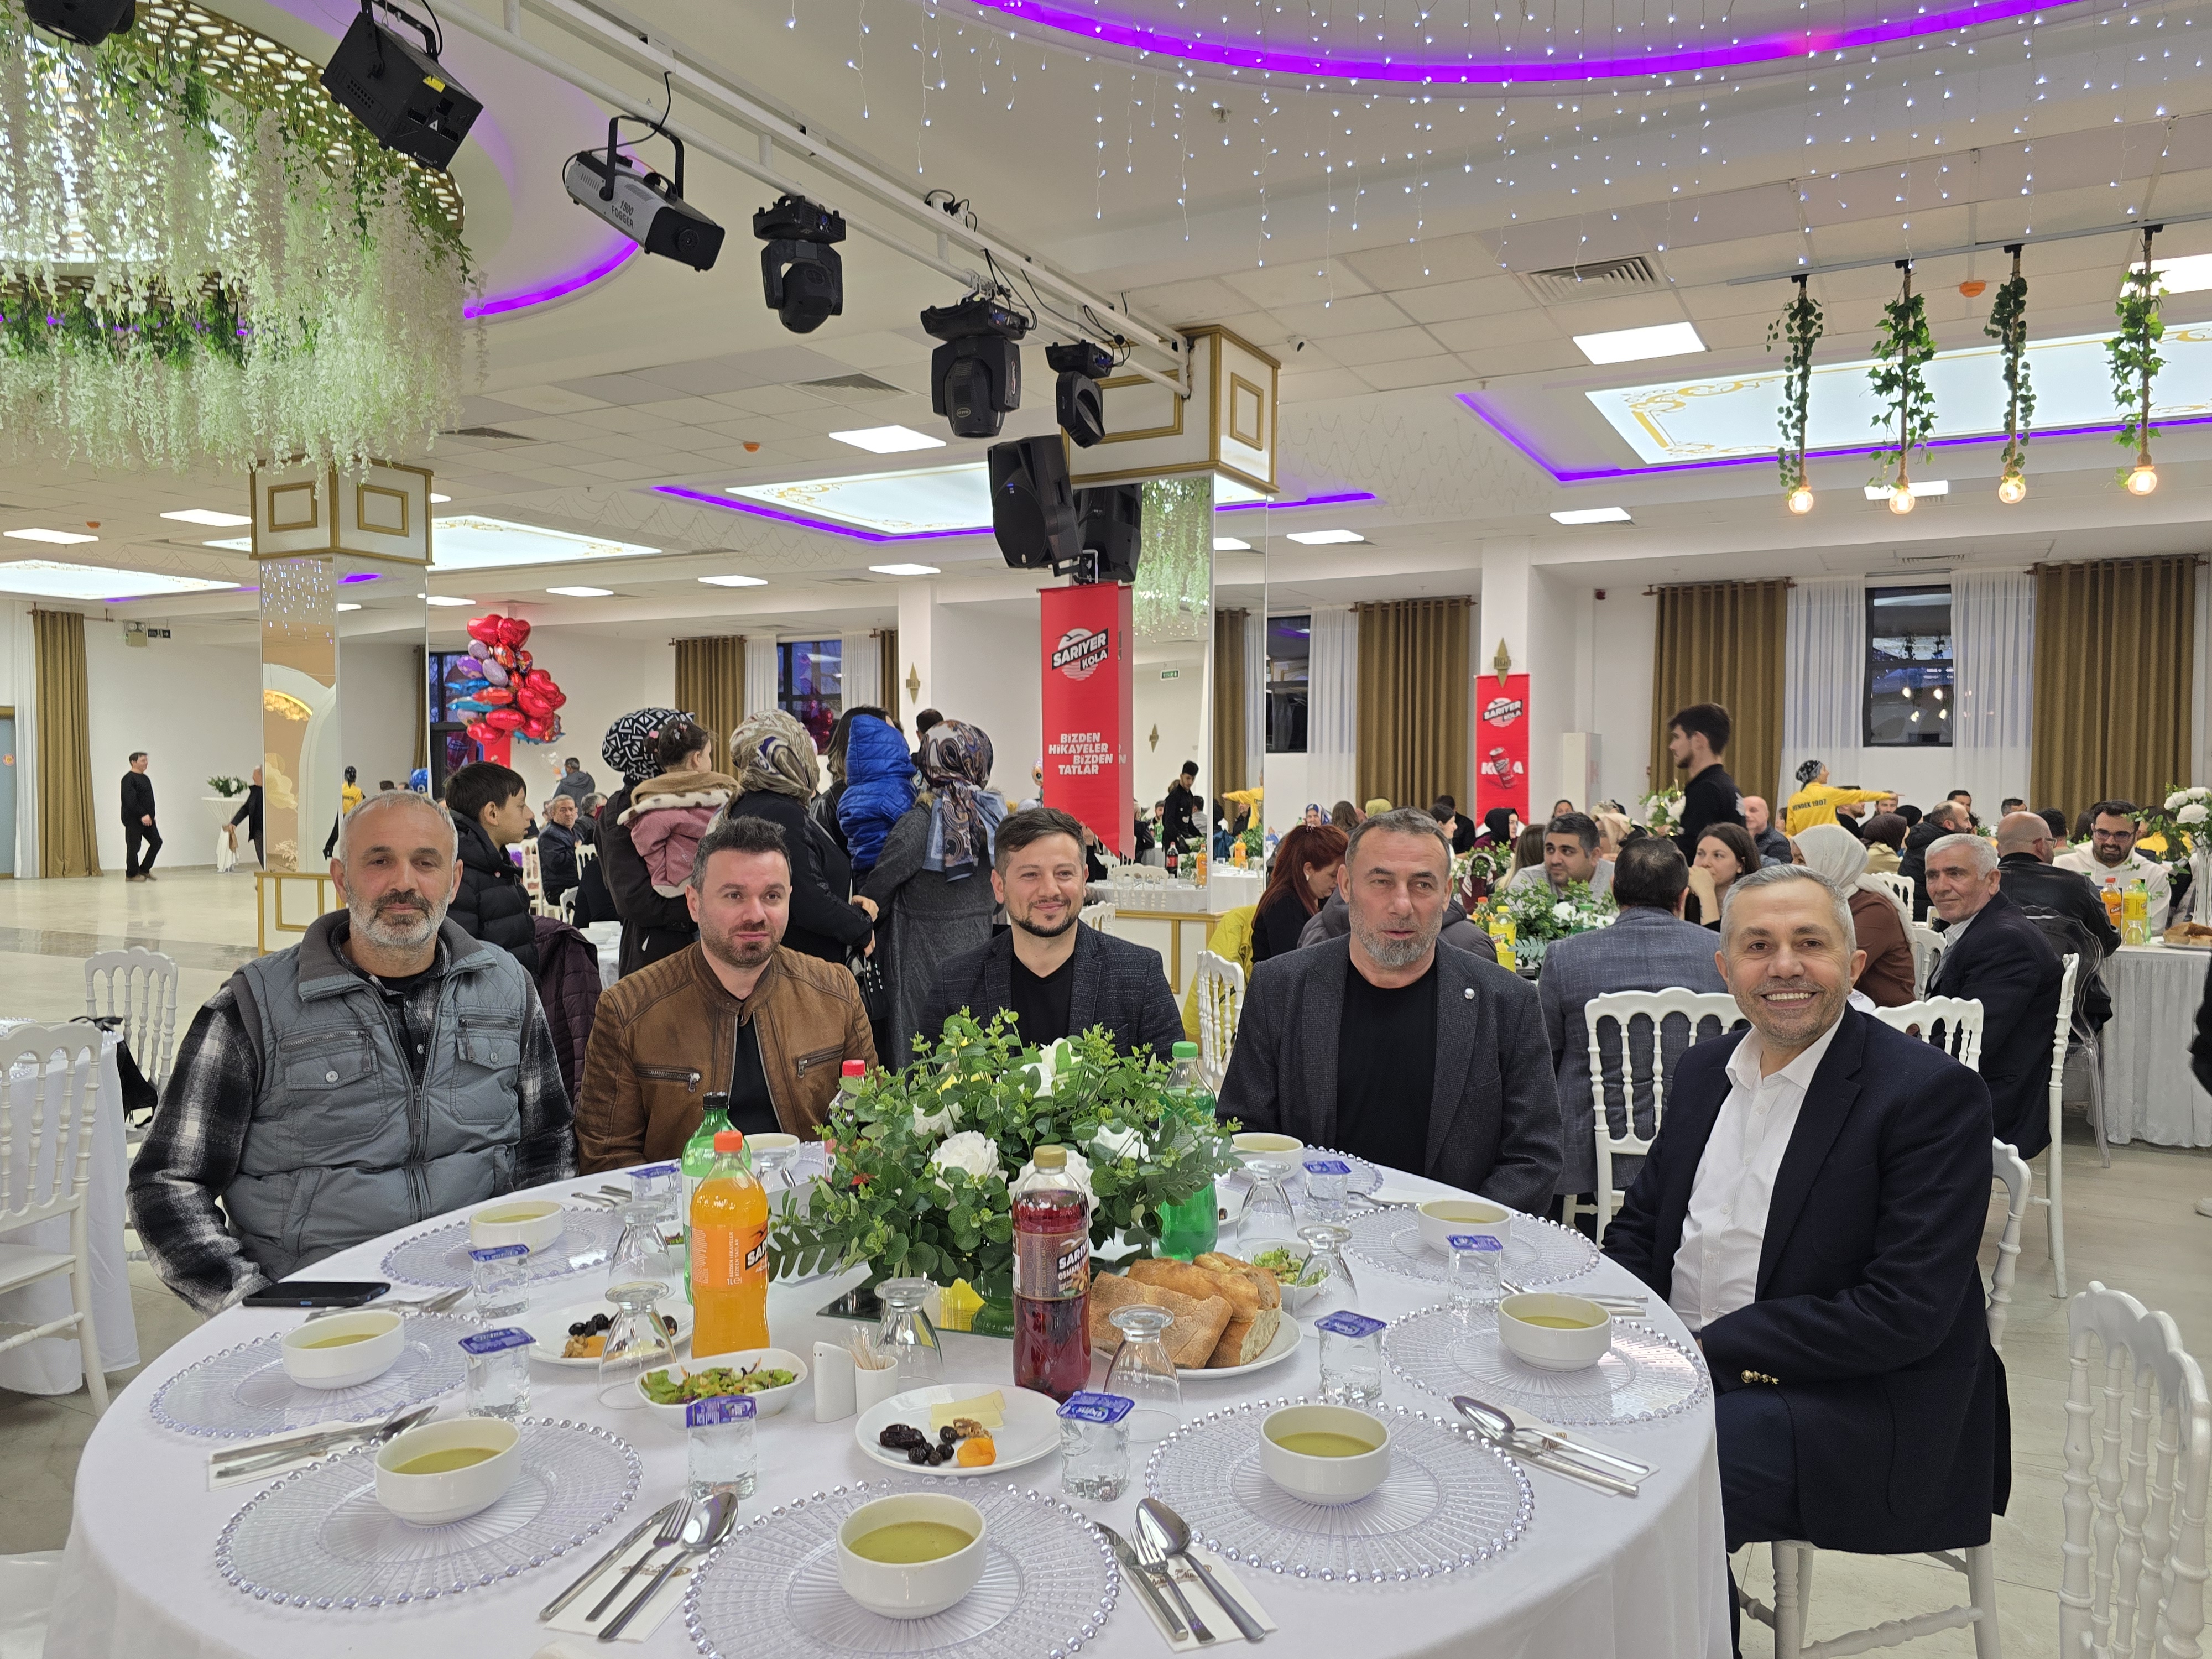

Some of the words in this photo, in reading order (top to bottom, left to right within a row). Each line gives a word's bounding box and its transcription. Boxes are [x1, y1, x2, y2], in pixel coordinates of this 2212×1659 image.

[620, 200, 634, 216] 1500
[612, 205, 634, 229] FOGGER
[1053, 633, 1107, 667] SARIYER
[1082, 650, 1108, 669] KOLA
[1484, 700, 1521, 720] SARIYER
[1058, 764, 1099, 775] TATLAR
[1481, 761, 1525, 775] KA
[1812, 799, 1827, 807] 1907
